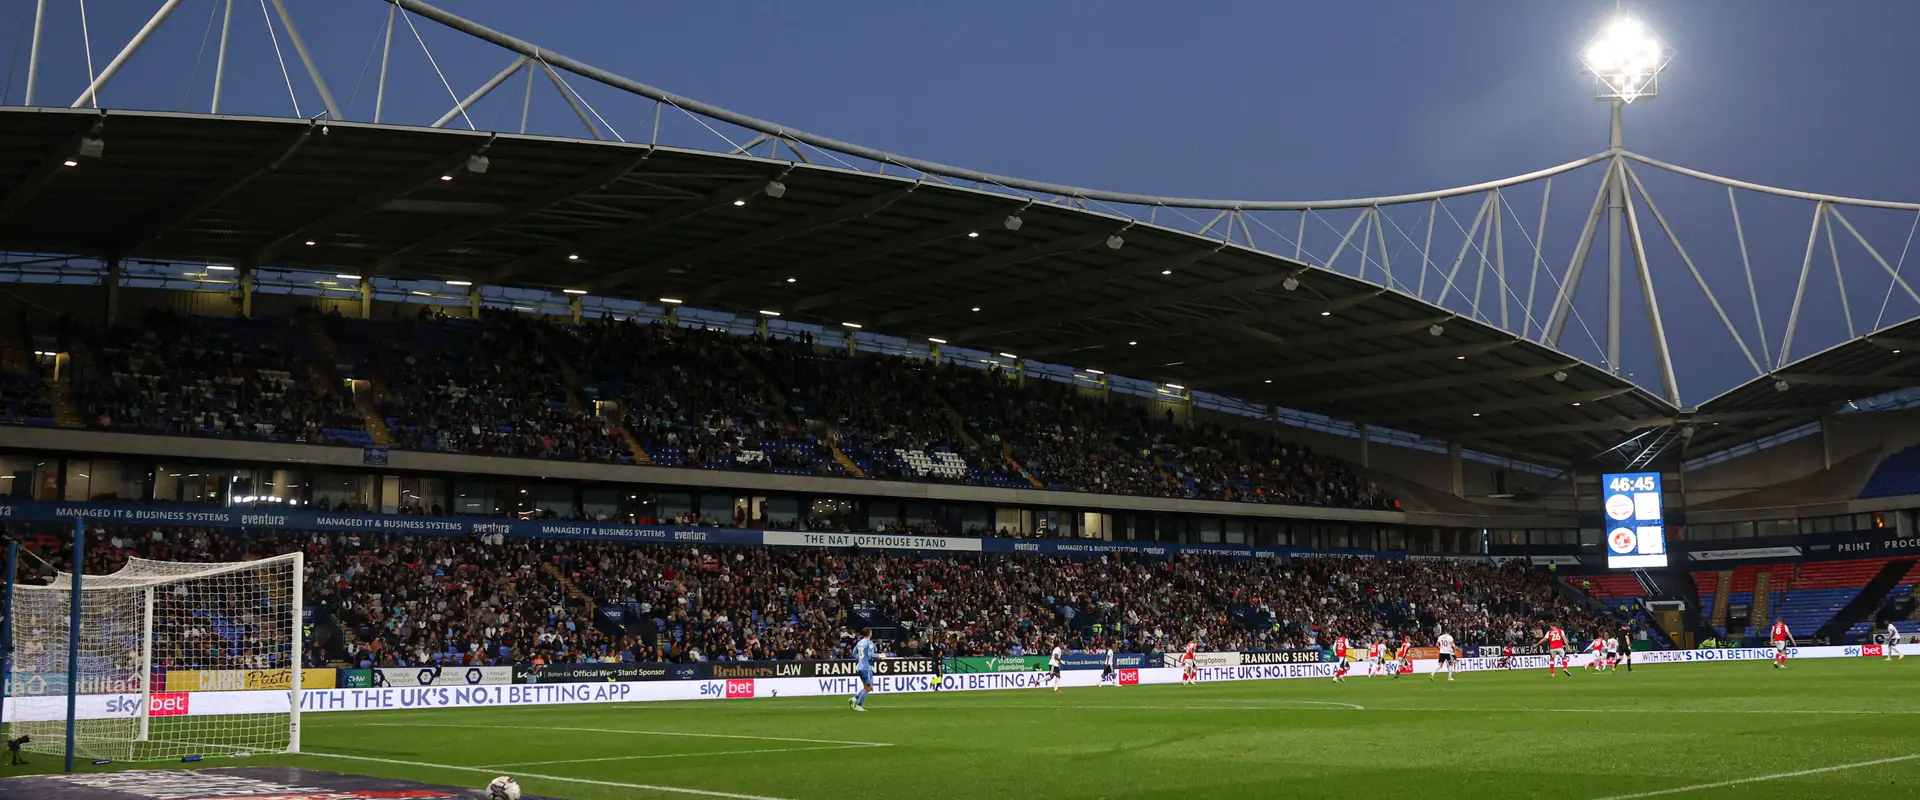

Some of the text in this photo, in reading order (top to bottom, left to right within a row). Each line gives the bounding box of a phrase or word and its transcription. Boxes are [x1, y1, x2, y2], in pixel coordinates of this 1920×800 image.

[1609, 476, 1655, 492] 46:45
[56, 507, 229, 522] MANAGED IT & BUSINESS SYSTEMS
[241, 513, 285, 525] eventura
[316, 516, 462, 531] MANAGED IT & BUSINESS SYSTEMS
[542, 525, 666, 538] MANAGED IT & BUSINESS SYSTEMS
[674, 530, 706, 541] eventura
[804, 534, 947, 548] THE NAT LOFTHOUSE STAND
[1014, 542, 1039, 551] eventura
[1838, 542, 1872, 553] PRINT
[1884, 539, 1920, 549] PROCE
[1551, 633, 1561, 641] 26
[1775, 627, 1782, 635] 8
[1540, 645, 1544, 653] &
[1695, 649, 1724, 660] NO.1
[1727, 648, 1774, 660] BETTING
[1785, 648, 1798, 658] PP
[1843, 646, 1881, 657] sky bet
[1116, 656, 1140, 665] eventura
[1240, 652, 1289, 664] FRANKING
[1292, 651, 1319, 662] SENSE
[1468, 658, 1484, 670] THE
[1525, 656, 1549, 668] BETTIN
[572, 669, 598, 678] Official
[618, 668, 638, 676] Stand
[638, 668, 666, 678] Sponsor
[713, 664, 802, 678] Brabners LAW
[815, 660, 933, 675] FRANKNG SENSE
[1214, 666, 1235, 679] THE
[1237, 665, 1262, 679] UK'S
[1264, 664, 1287, 679] NO.1
[1290, 663, 1331, 677] BETTING
[247, 670, 306, 687] Pastis
[1120, 671, 1137, 682] bet
[76, 675, 124, 693] tilita
[700, 681, 752, 697] sky bet
[818, 678, 858, 694] WITH
[871, 677, 890, 692] HE
[894, 675, 928, 692] UK'S
[969, 673, 1025, 689] BETTING
[352, 689, 394, 708] THE
[401, 688, 449, 707] UK'S
[455, 687, 501, 705] NO.1
[509, 684, 590, 703] BETTING
[595, 683, 630, 701] APP
[106, 695, 184, 715] sky bet
